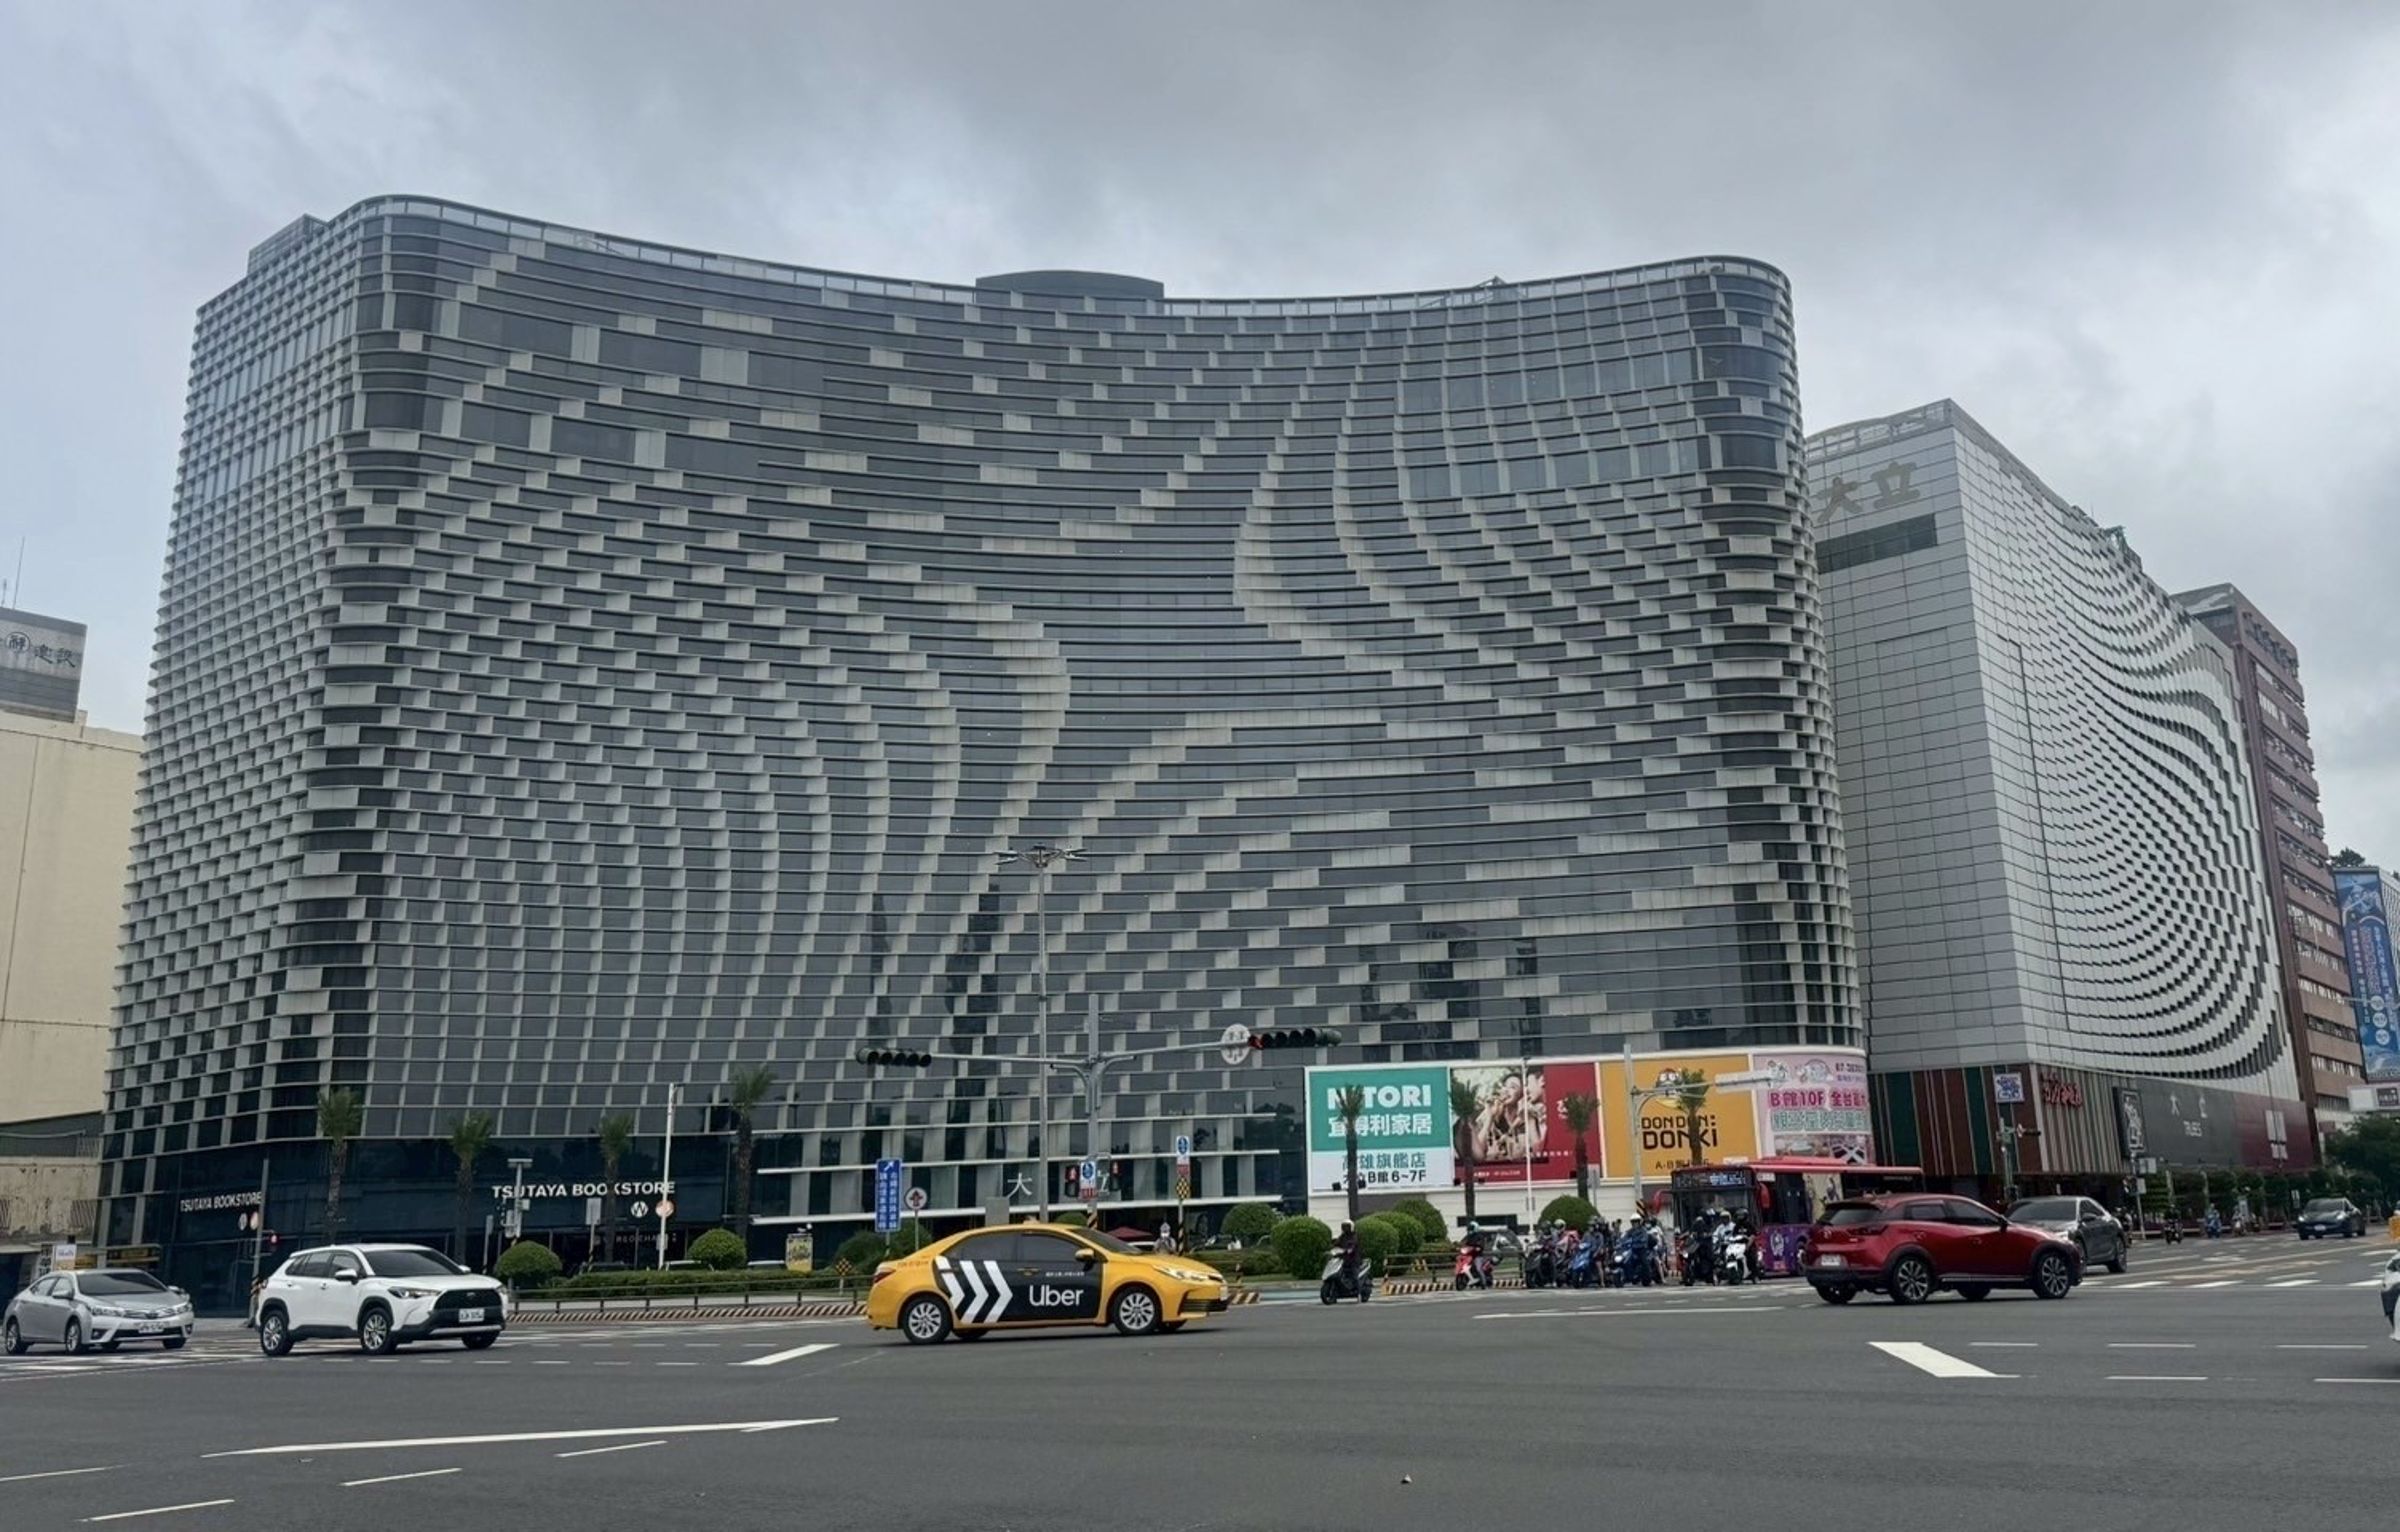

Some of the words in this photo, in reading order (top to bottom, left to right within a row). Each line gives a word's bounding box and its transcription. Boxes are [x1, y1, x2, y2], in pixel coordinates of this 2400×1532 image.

[1815, 460, 1922, 524] 大立
[1327, 1085, 1432, 1110] NTORI
[1641, 1117, 1673, 1129] DON
[492, 1183, 567, 1199] TSUTAYA
[572, 1178, 675, 1196] BOOKSTORE
[180, 1198, 212, 1212] TSUTAYA
[214, 1191, 262, 1209] BOOKSTORE
[1029, 1284, 1084, 1306] Uber
